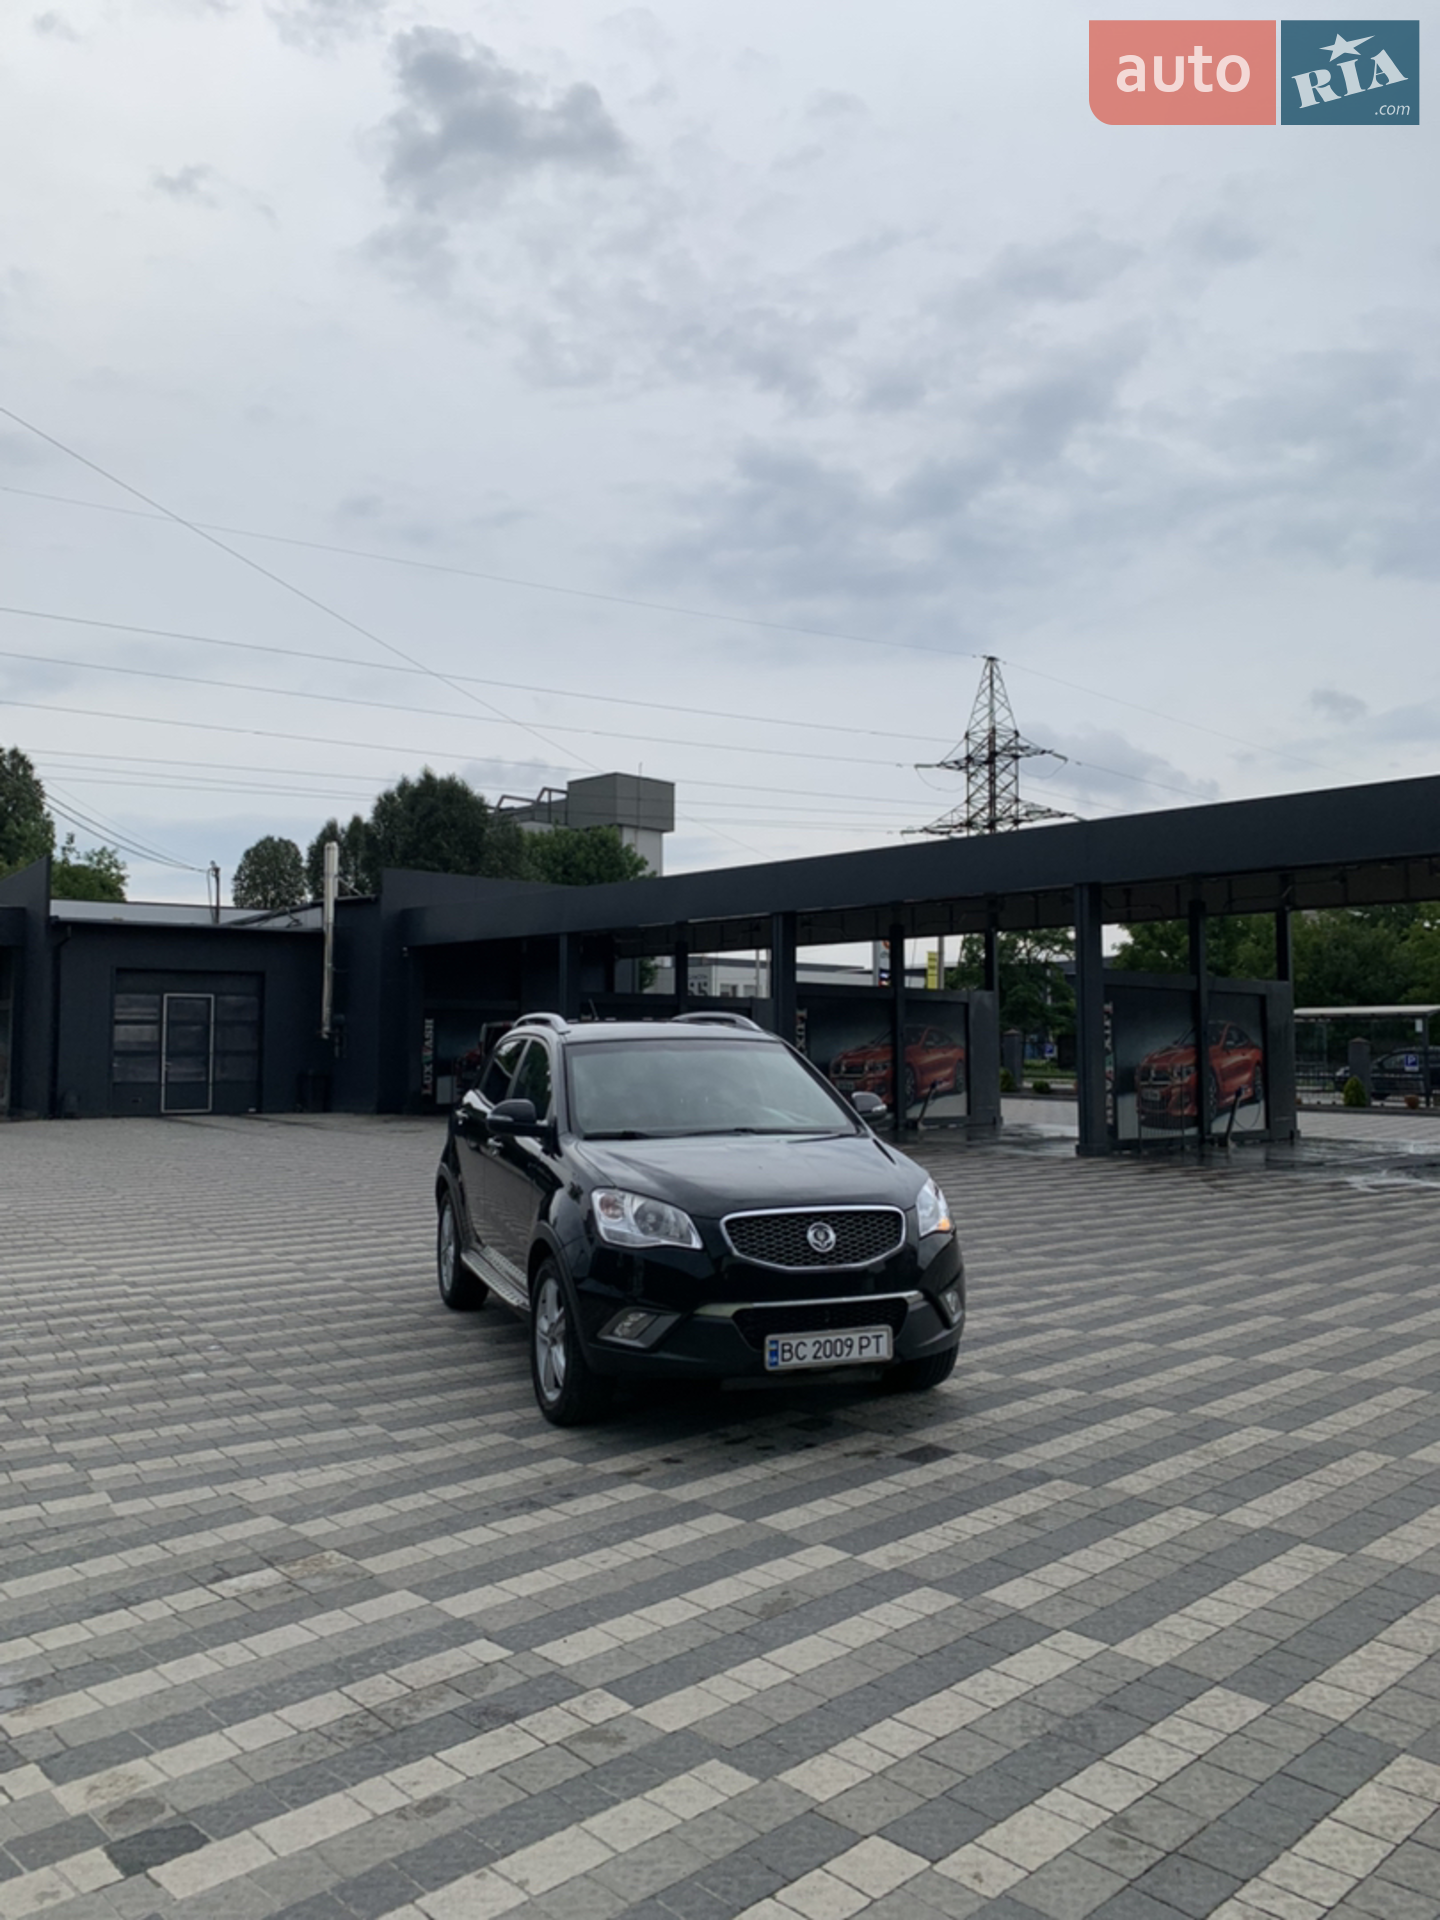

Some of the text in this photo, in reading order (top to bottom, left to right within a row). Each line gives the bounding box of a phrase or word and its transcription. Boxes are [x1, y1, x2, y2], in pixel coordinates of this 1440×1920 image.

[781, 1334, 884, 1362] BC 2009 PT
